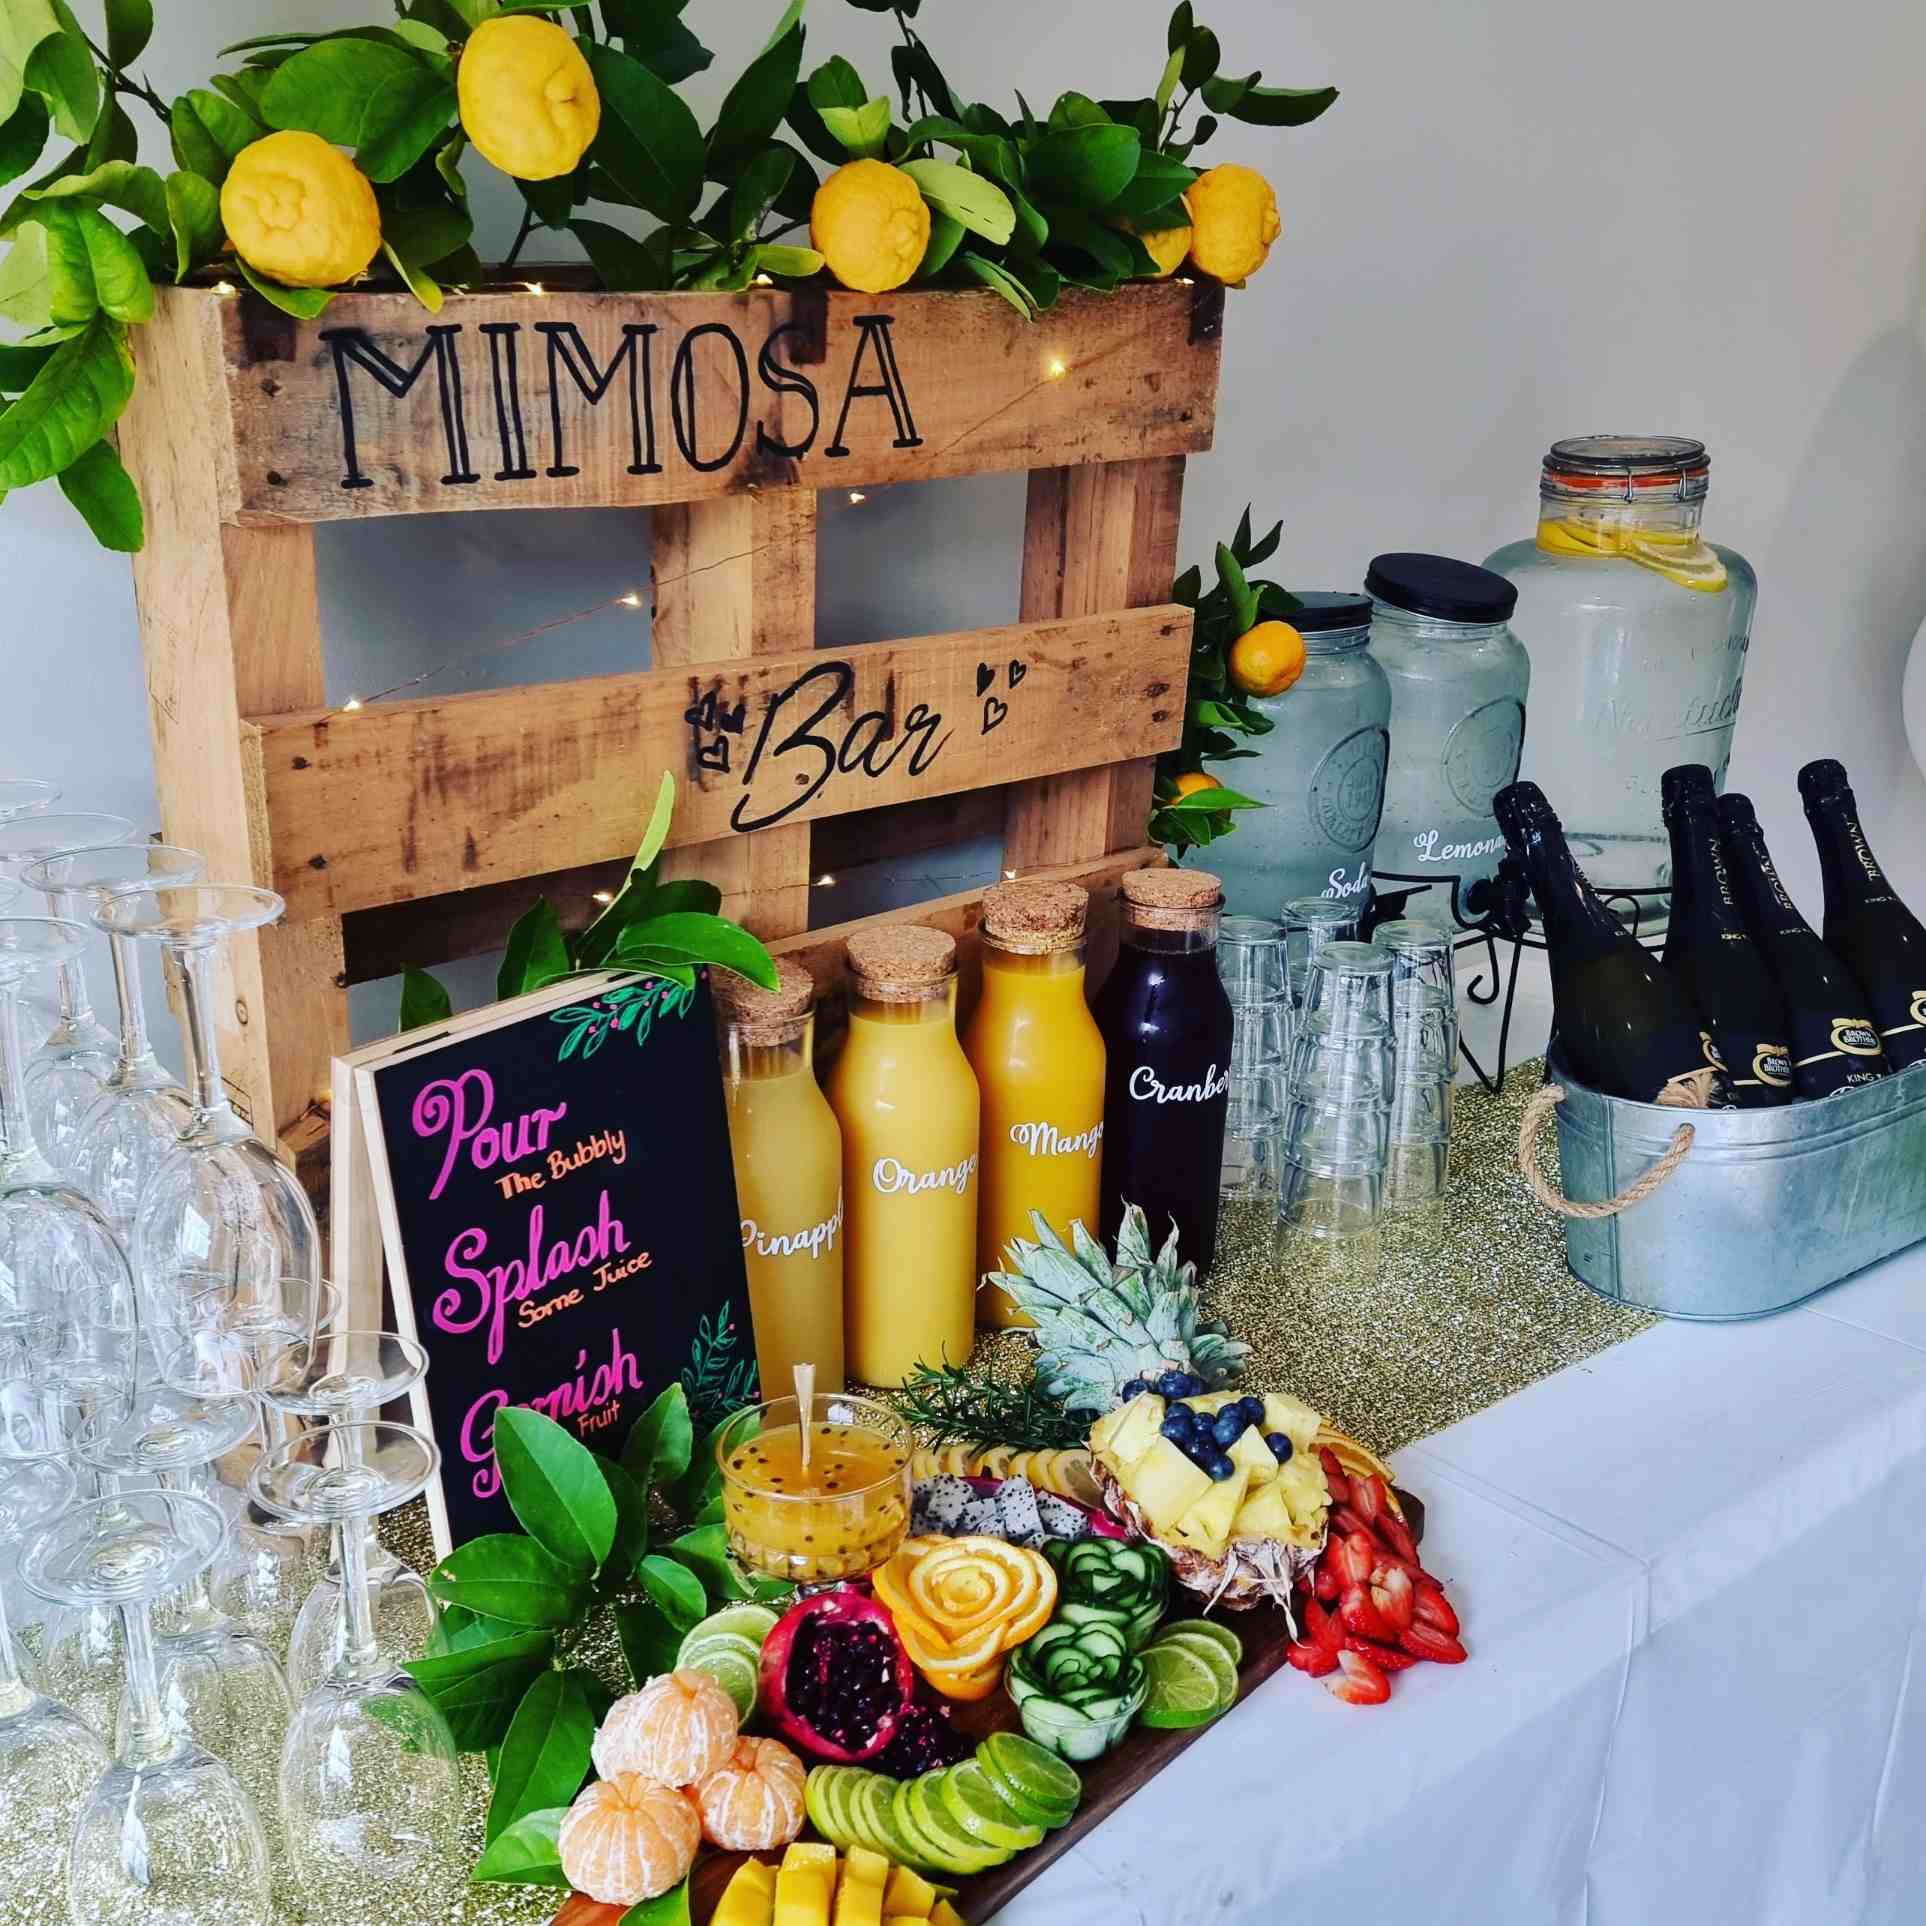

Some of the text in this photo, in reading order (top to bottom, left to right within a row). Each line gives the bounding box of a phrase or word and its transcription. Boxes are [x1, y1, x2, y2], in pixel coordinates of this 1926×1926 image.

[318, 314, 924, 489] MIMOSA
[730, 661, 954, 833] Bar
[411, 1069, 567, 1200] Pour
[494, 1129, 626, 1200] The Bubbly
[432, 1189, 631, 1365] Splash
[517, 1251, 652, 1328] Some Juice
[460, 1327, 643, 1498] Grnish
[577, 1399, 621, 1438] Fruit
